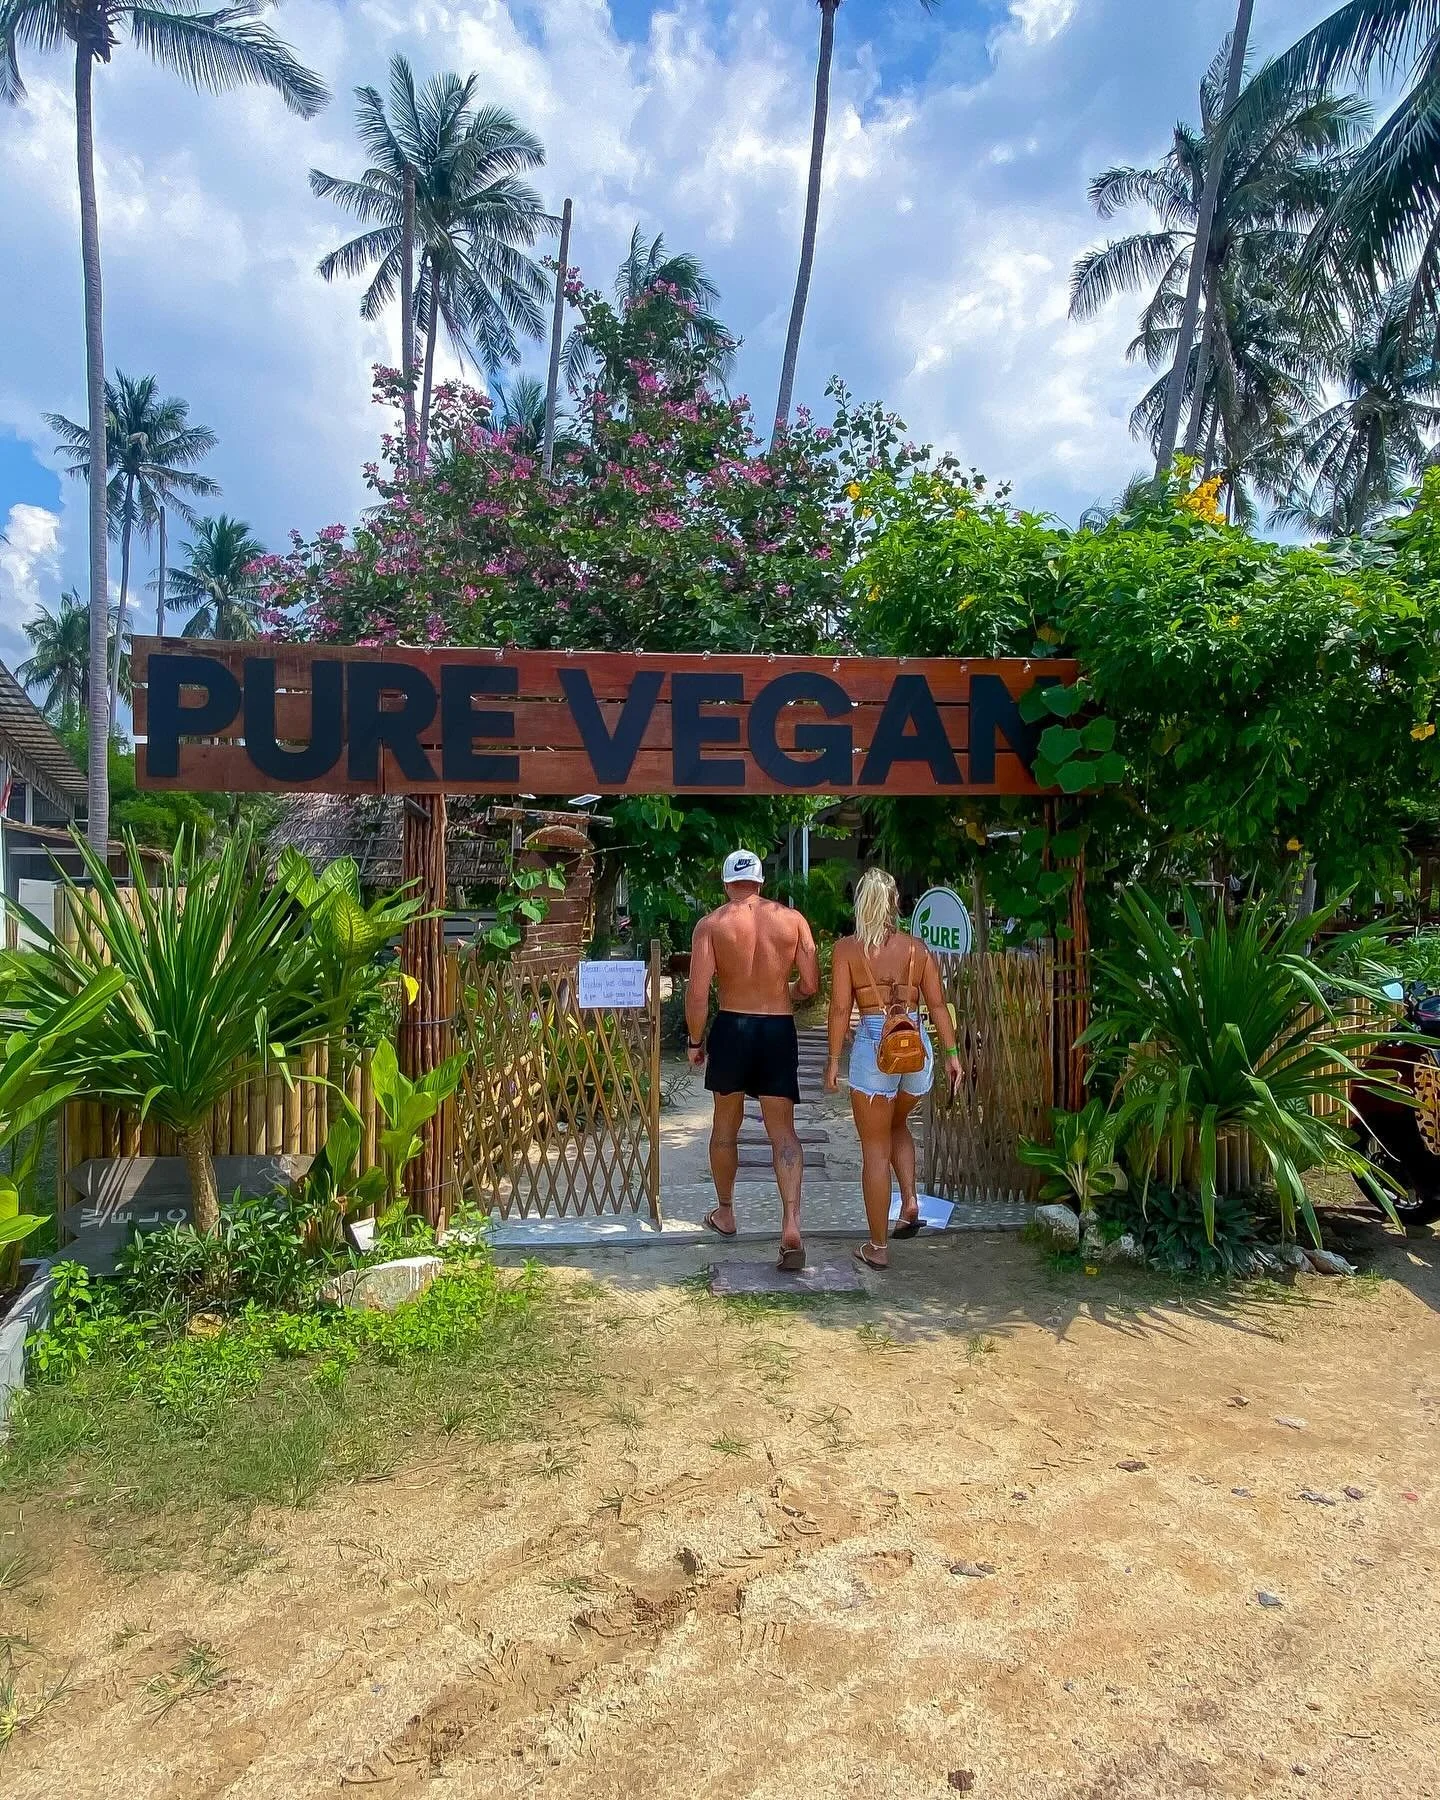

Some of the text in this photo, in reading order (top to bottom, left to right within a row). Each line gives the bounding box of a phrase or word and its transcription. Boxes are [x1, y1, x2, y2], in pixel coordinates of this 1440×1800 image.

[146, 654, 1062, 787] PURE VEGAN
[920, 925, 960, 950] PURE
